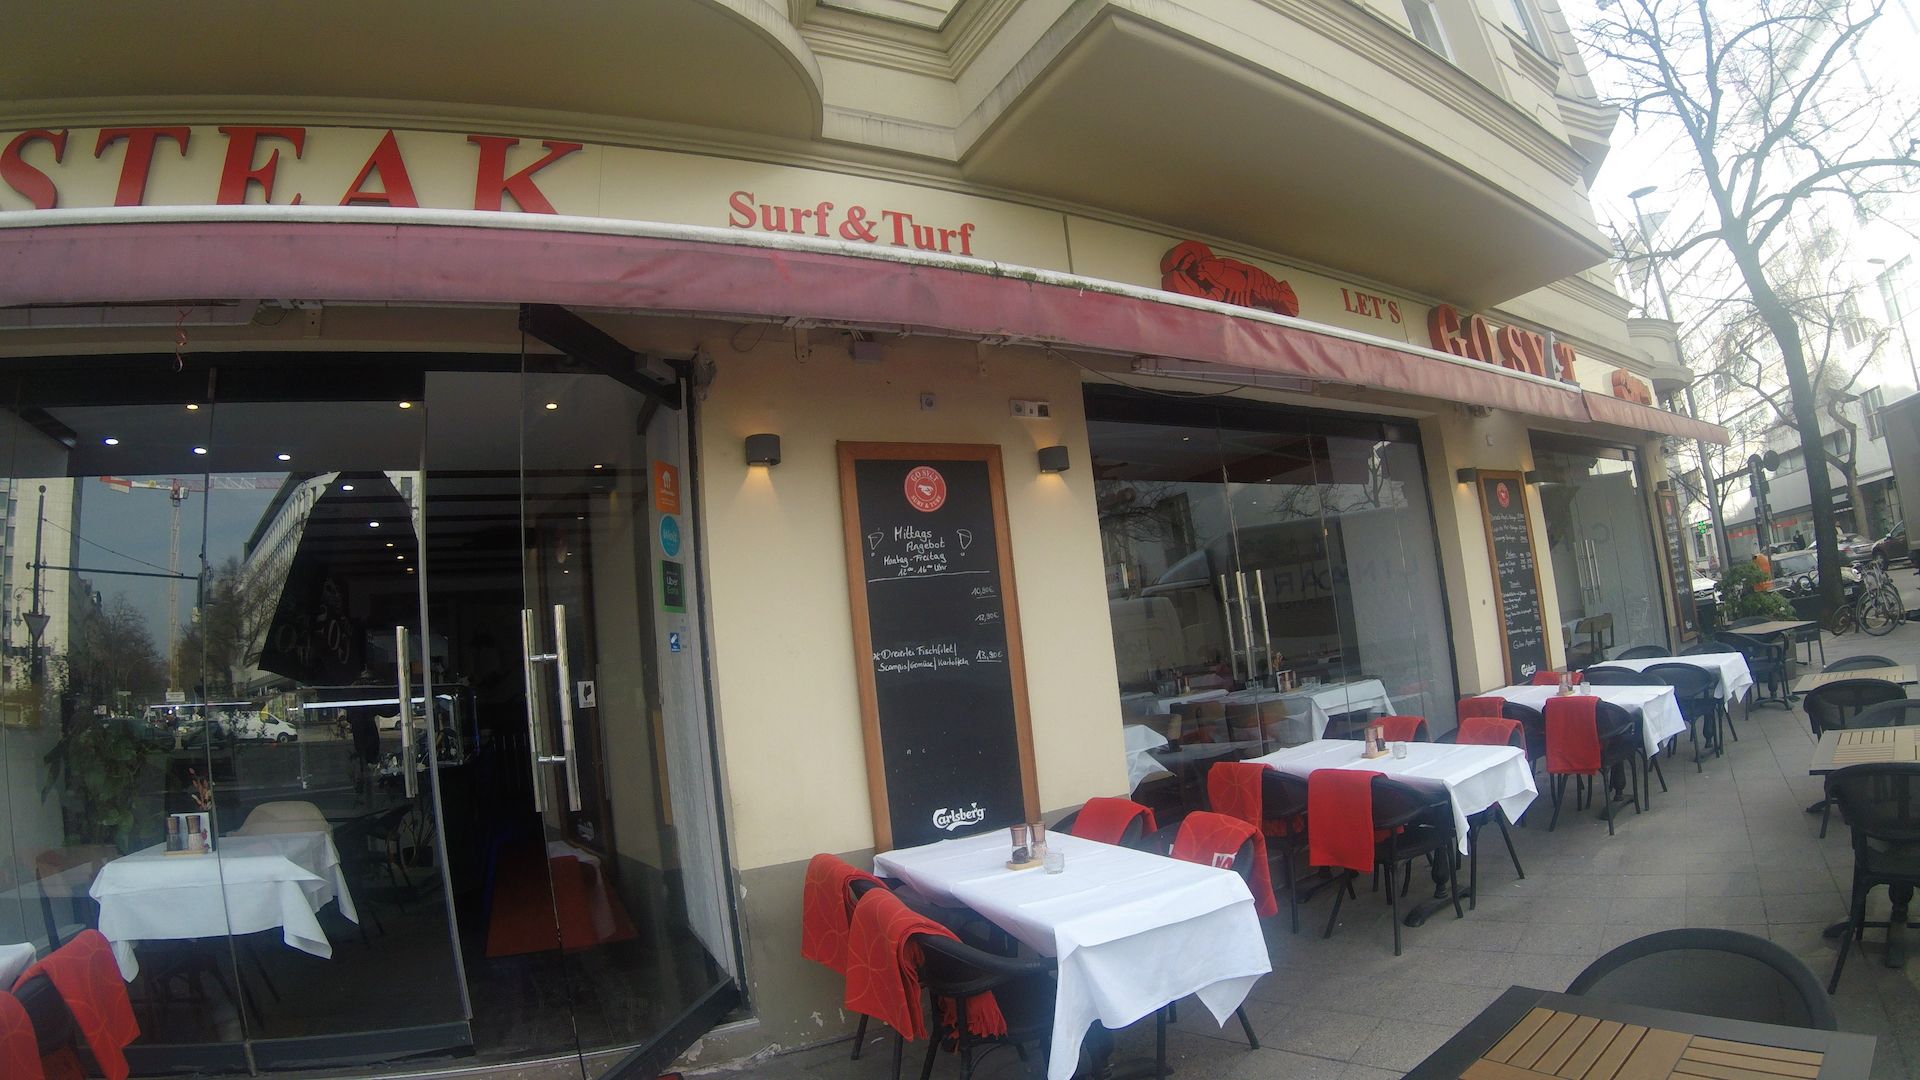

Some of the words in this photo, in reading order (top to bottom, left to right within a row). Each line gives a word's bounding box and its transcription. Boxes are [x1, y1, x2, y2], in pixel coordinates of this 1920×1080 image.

[0, 126, 583, 215] STEAK
[729, 190, 834, 237] Surf
[838, 204, 879, 243] &
[882, 209, 976, 257] Turf
[1340, 287, 1401, 324] LET'S
[1427, 303, 1497, 364] GO
[1497, 325, 1577, 385] SYLT
[894, 525, 933, 542] Mittags
[906, 536, 946, 554] Angebot
[932, 804, 985, 831] Carlsberg
